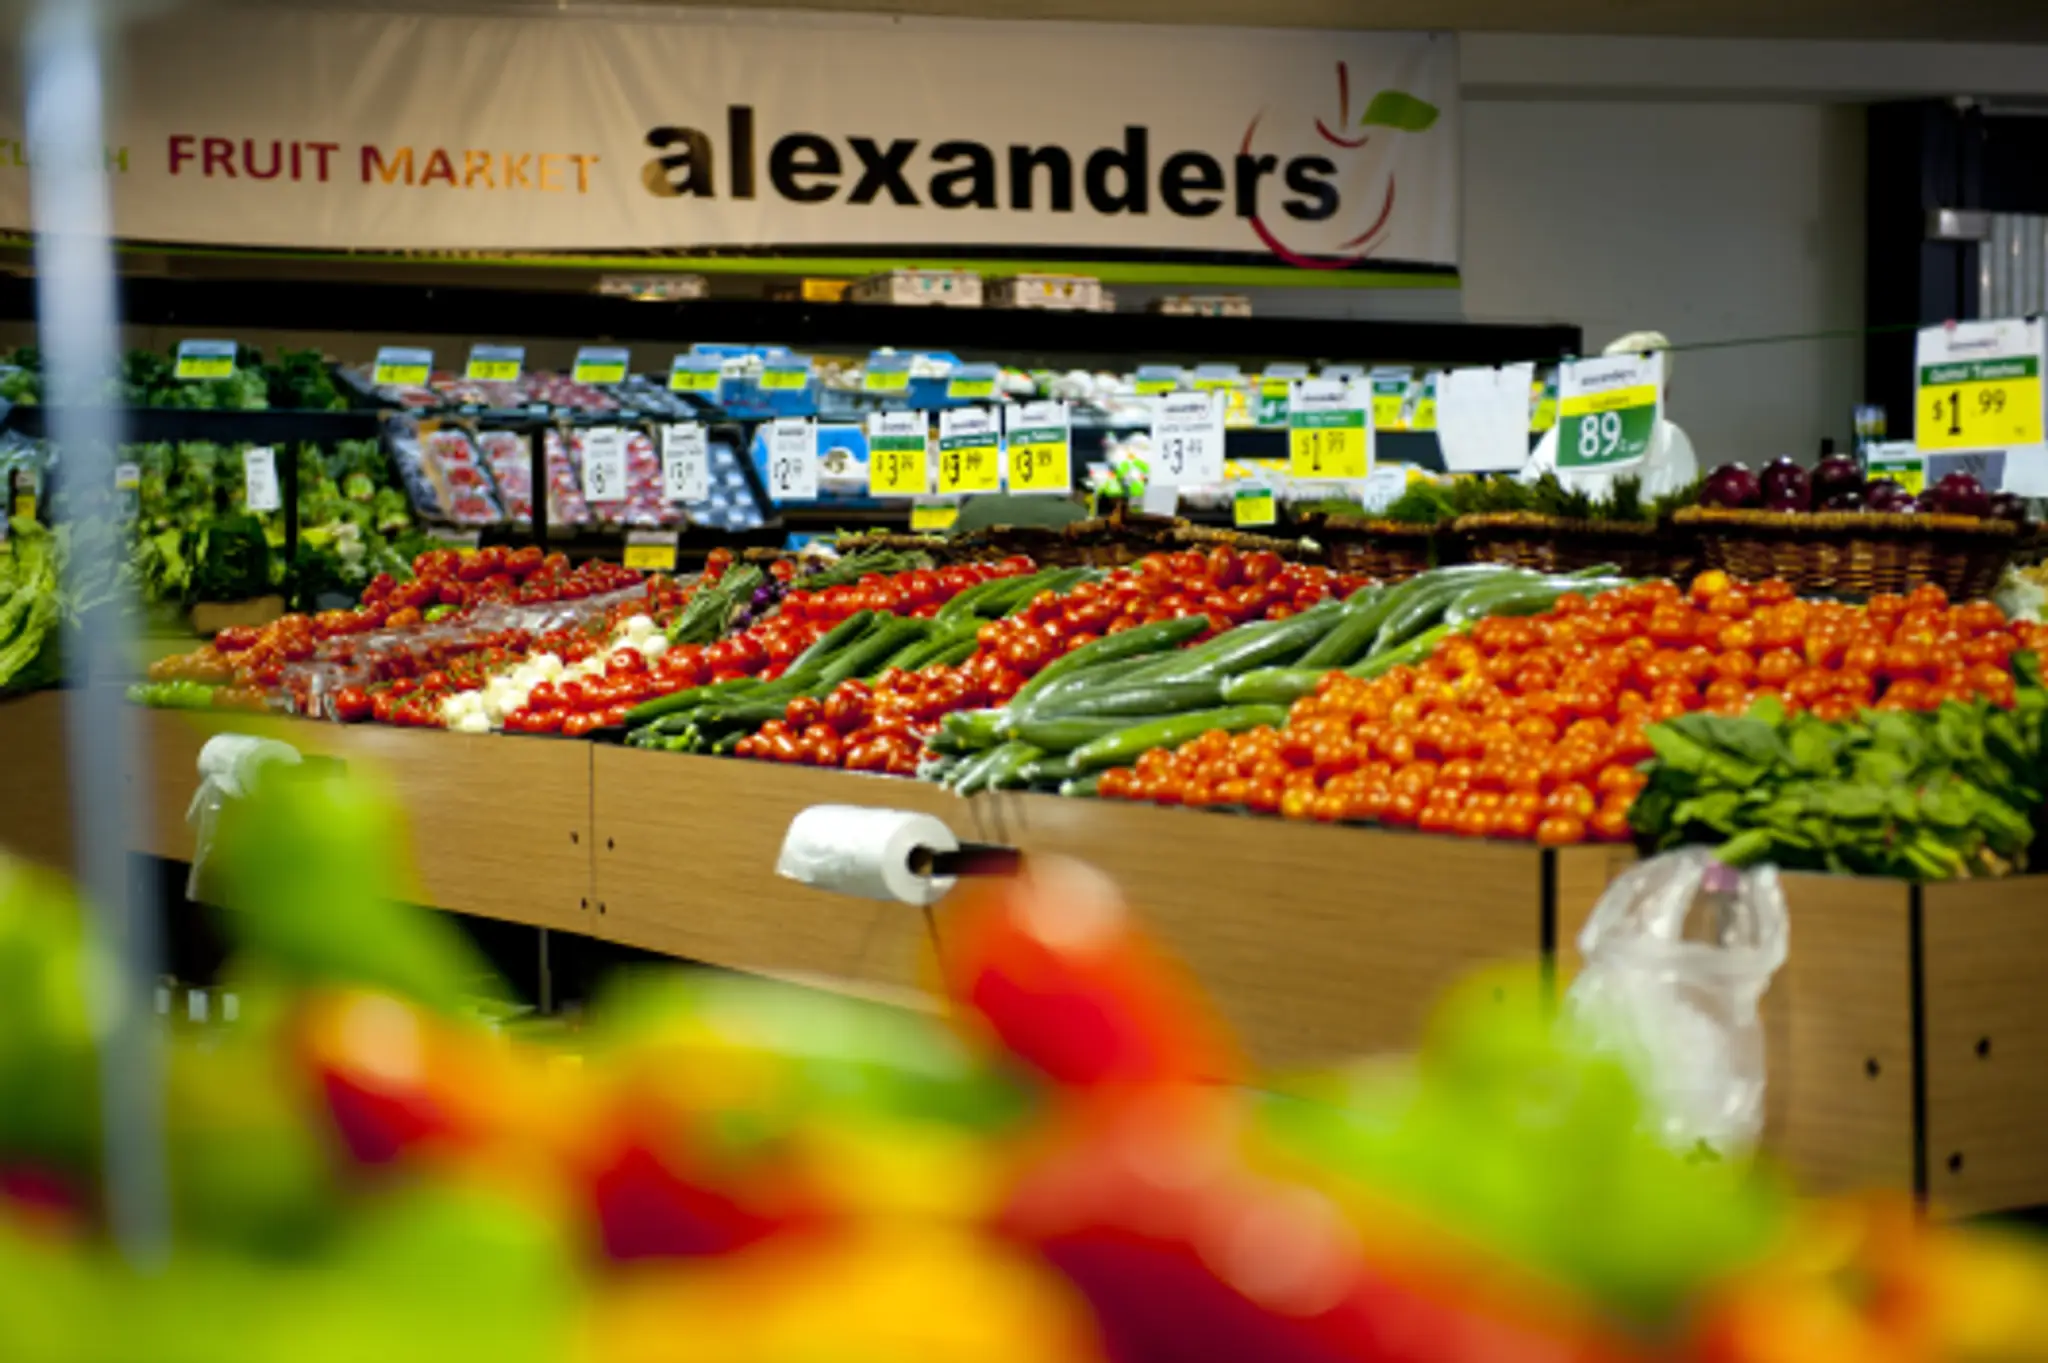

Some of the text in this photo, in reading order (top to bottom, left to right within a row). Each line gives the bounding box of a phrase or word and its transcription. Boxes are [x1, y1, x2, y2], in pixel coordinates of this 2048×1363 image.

[168, 134, 339, 183] FRUIT
[359, 144, 600, 194] MARKET
[641, 104, 1340, 221] alexanders
[1978, 387, 2008, 416] 99
[1578, 410, 1622, 458] 89
